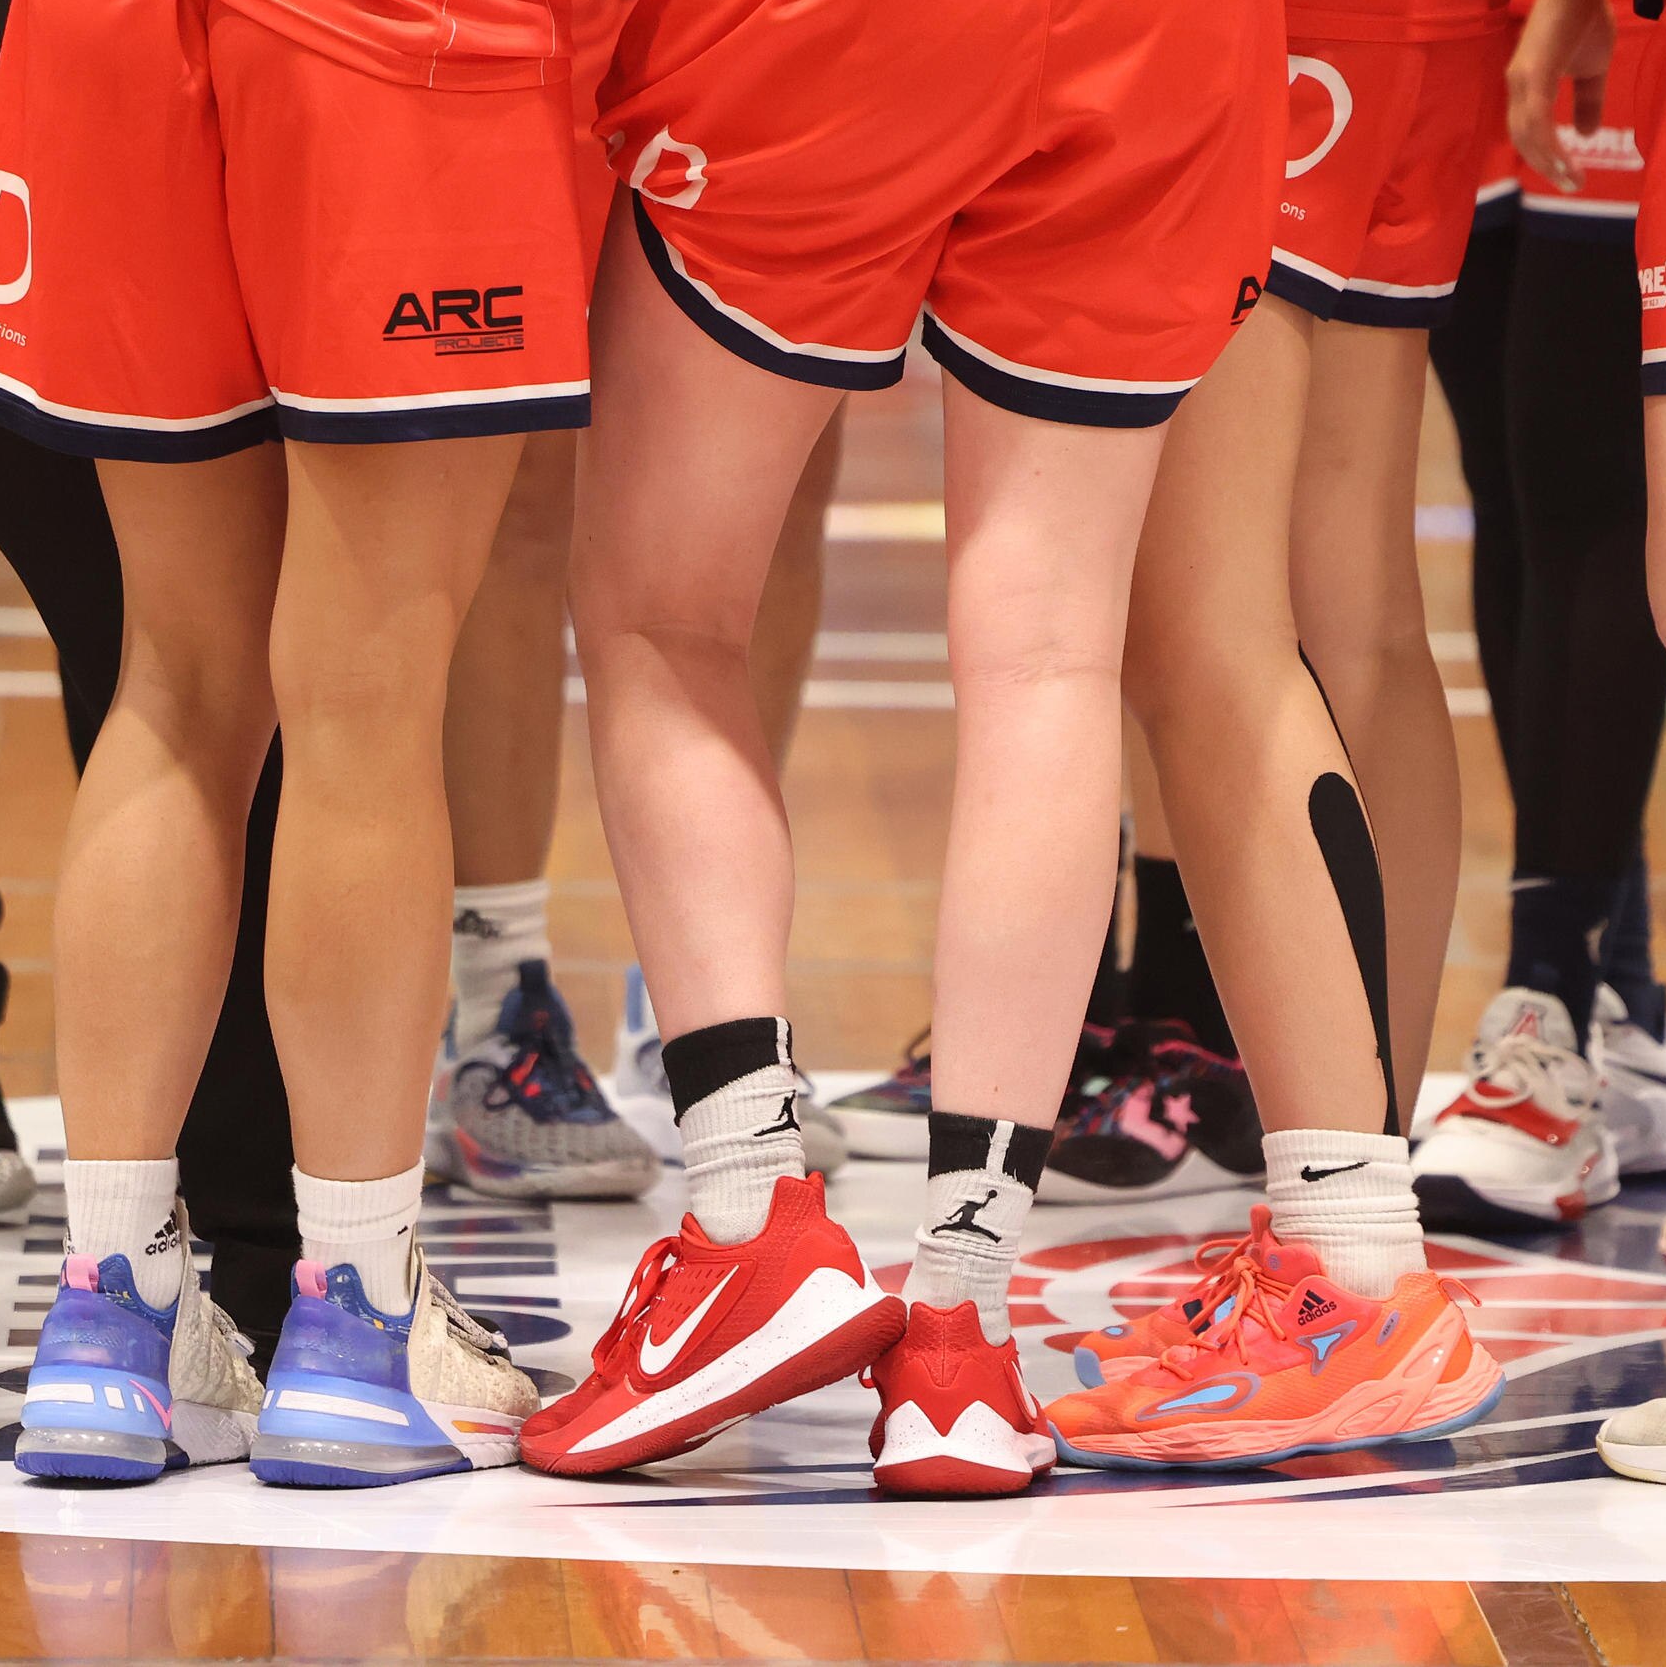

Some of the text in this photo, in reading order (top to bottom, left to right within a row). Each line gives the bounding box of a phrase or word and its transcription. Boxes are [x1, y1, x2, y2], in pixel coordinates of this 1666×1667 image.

[383, 286, 523, 334] ARC
[435, 334, 524, 350] PROJECTS
[144, 1234, 178, 1256] adid
[1297, 1300, 1337, 1326] adidas
